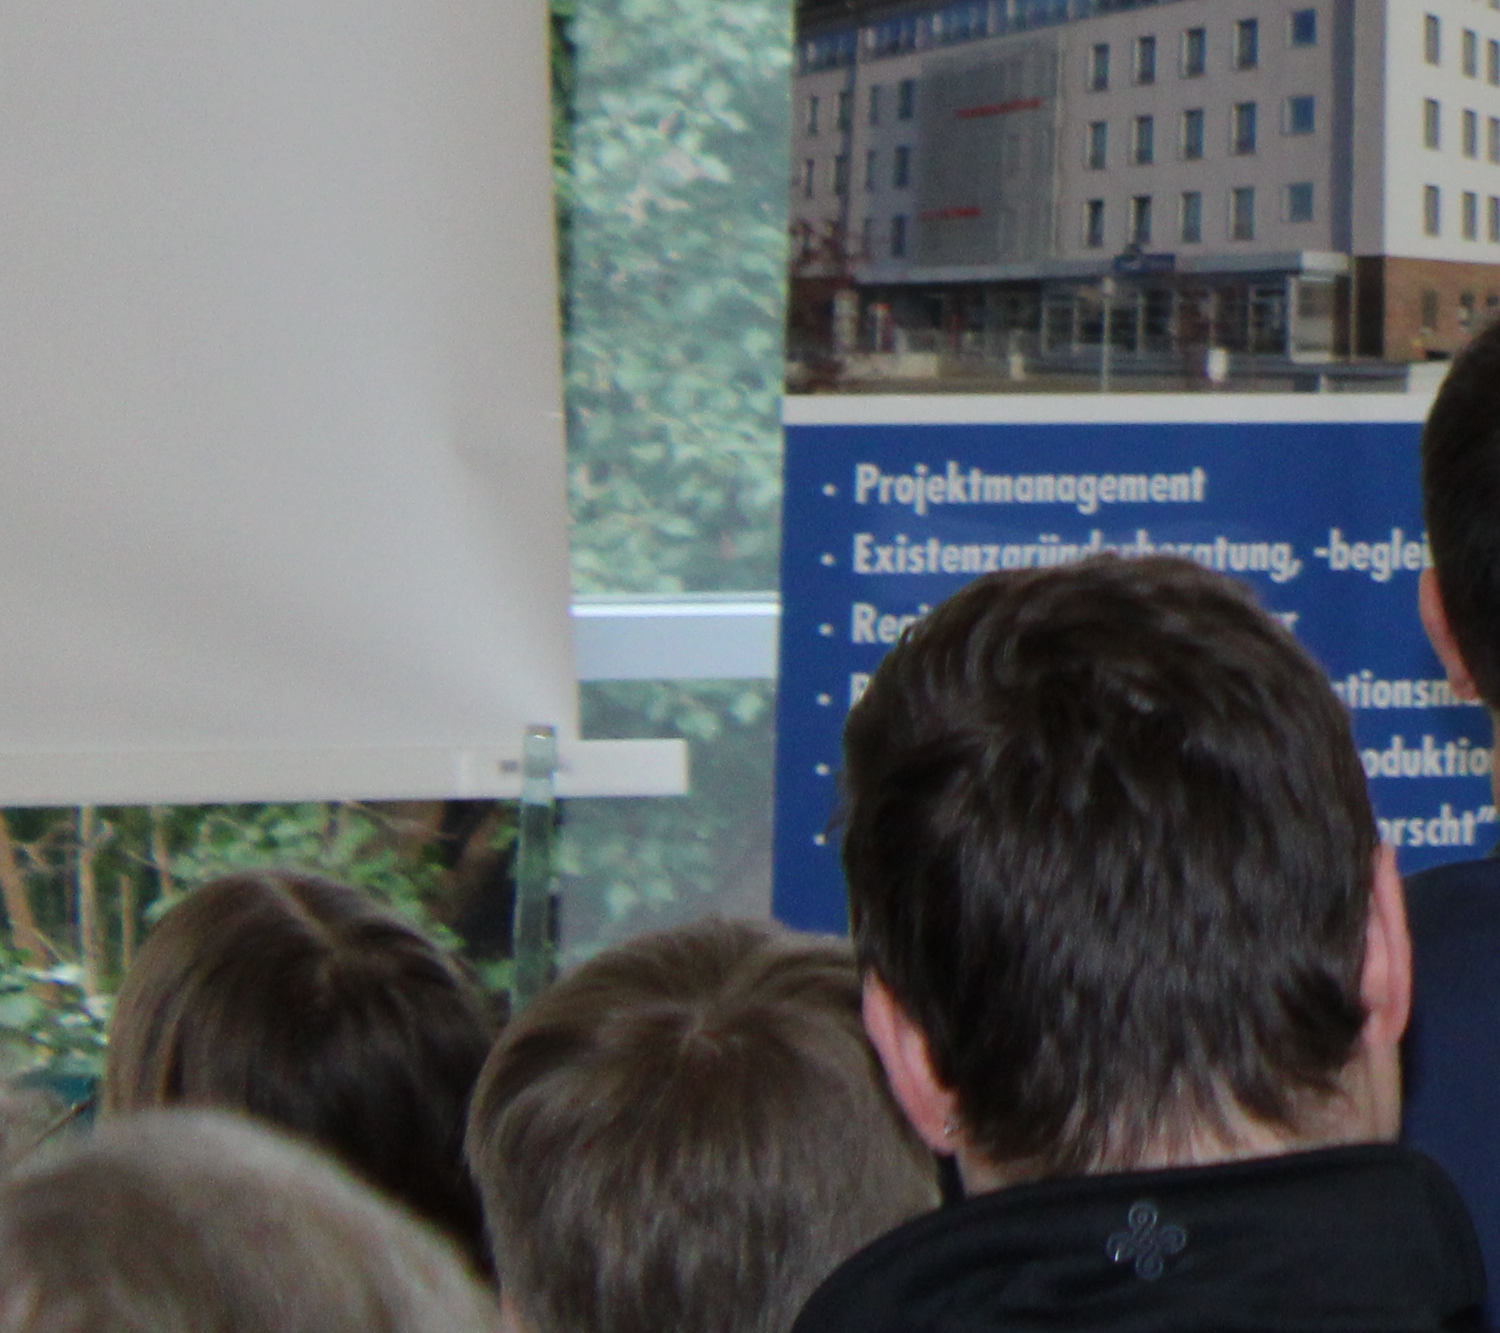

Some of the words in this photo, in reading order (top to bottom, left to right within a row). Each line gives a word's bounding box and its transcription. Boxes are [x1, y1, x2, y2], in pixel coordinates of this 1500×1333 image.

[854, 461, 1206, 516] Projektmanagement
[1313, 527, 1435, 582] -beglei
[1360, 735, 1493, 778] oduktio
